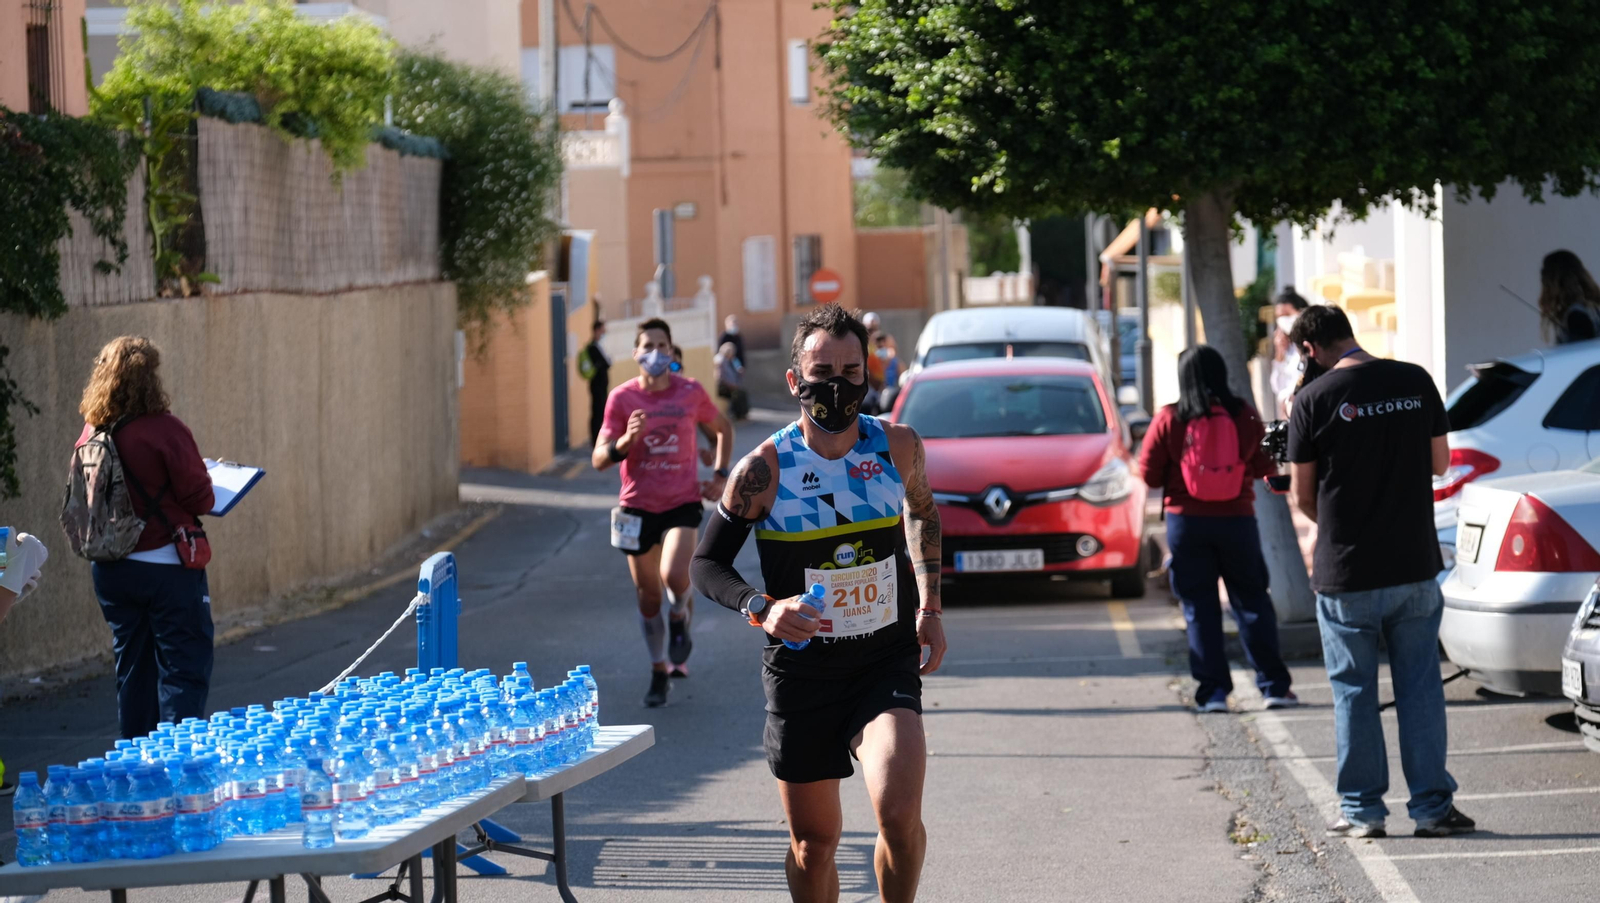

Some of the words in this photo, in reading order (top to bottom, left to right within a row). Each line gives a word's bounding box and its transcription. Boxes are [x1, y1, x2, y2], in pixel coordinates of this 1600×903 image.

[1357, 399, 1422, 418] RECDRON
[849, 460, 883, 480] ego
[802, 484, 821, 492] mobel
[836, 551, 855, 560] run
[831, 572, 860, 582] CIRCUITO
[861, 567, 878, 579] 2020
[831, 580, 854, 588] CARRERAS
[854, 576, 878, 586] POPULARES
[833, 583, 877, 608] 210
[843, 605, 871, 617] JUANSA
